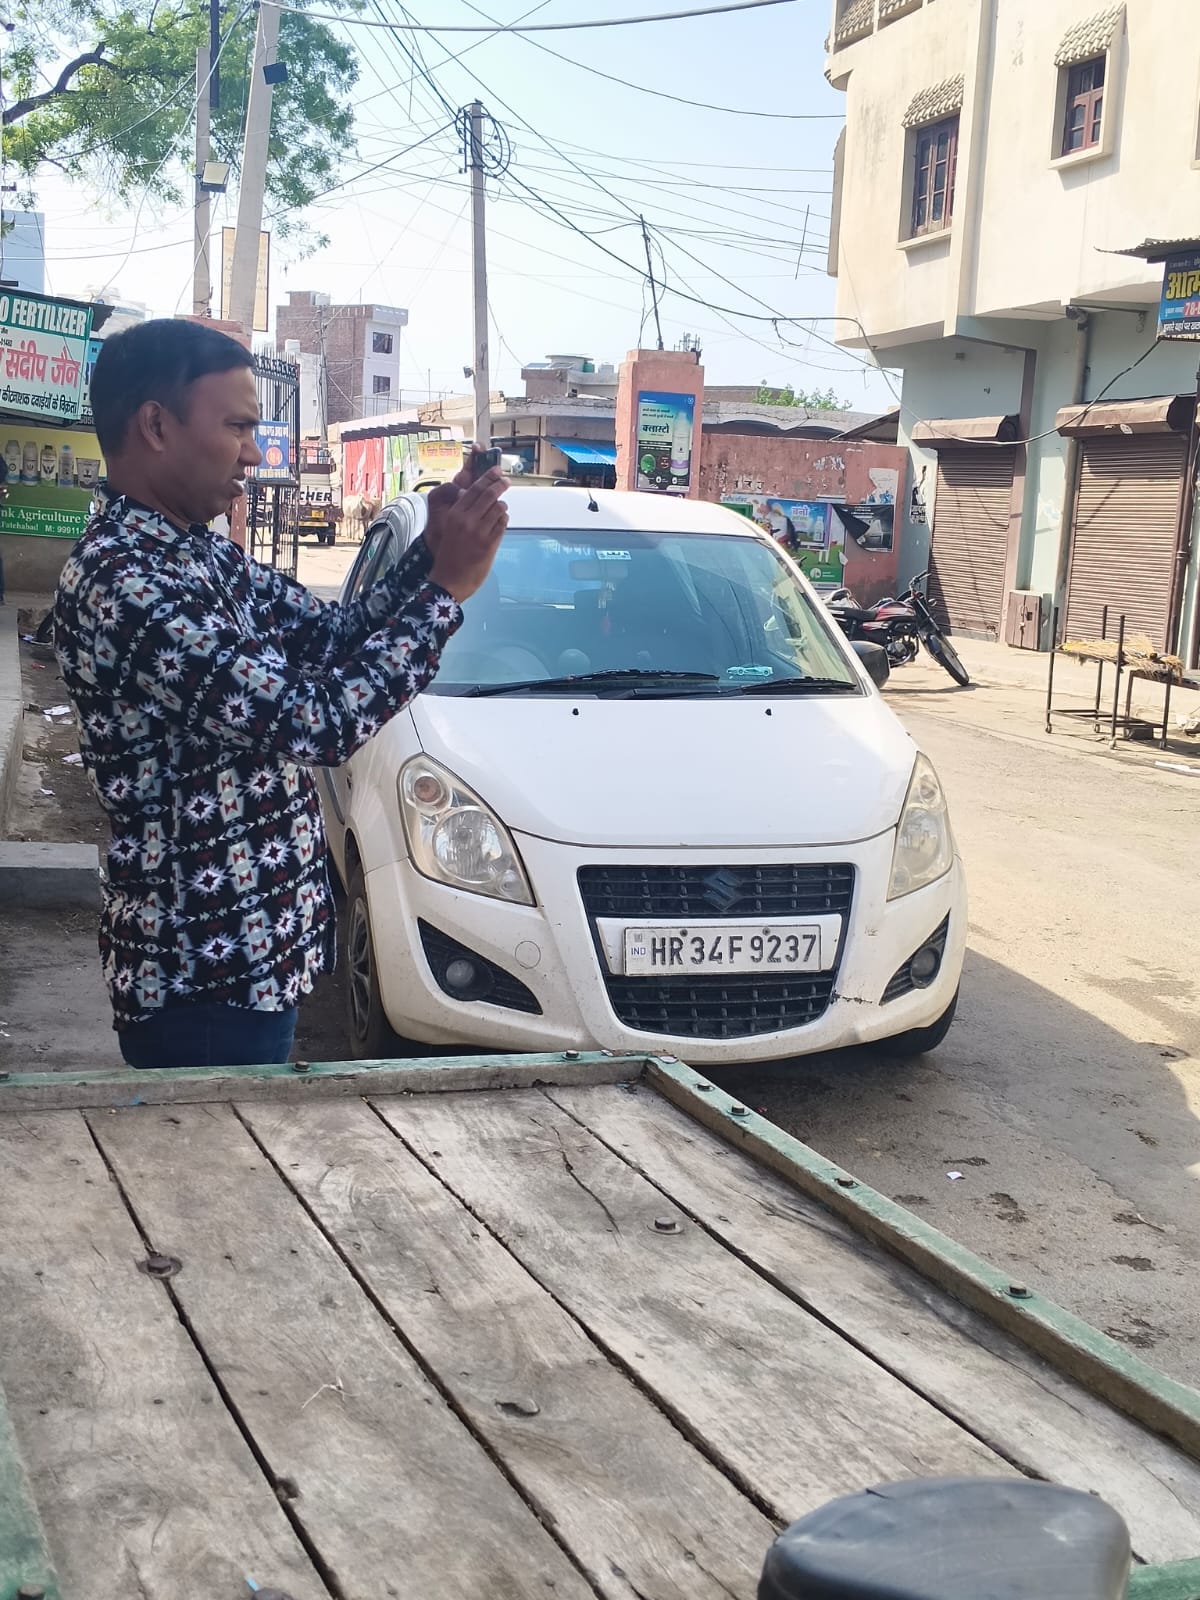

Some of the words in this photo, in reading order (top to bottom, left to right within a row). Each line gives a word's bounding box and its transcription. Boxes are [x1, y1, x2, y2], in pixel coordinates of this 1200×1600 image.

[12, 300, 86, 336] FERTILIZER
[6, 340, 48, 382] संदीप
[51, 345, 81, 388] जैन
[52, 395, 59, 409] के
[18, 509, 81, 523] Agriculture
[631, 947, 646, 956] IND
